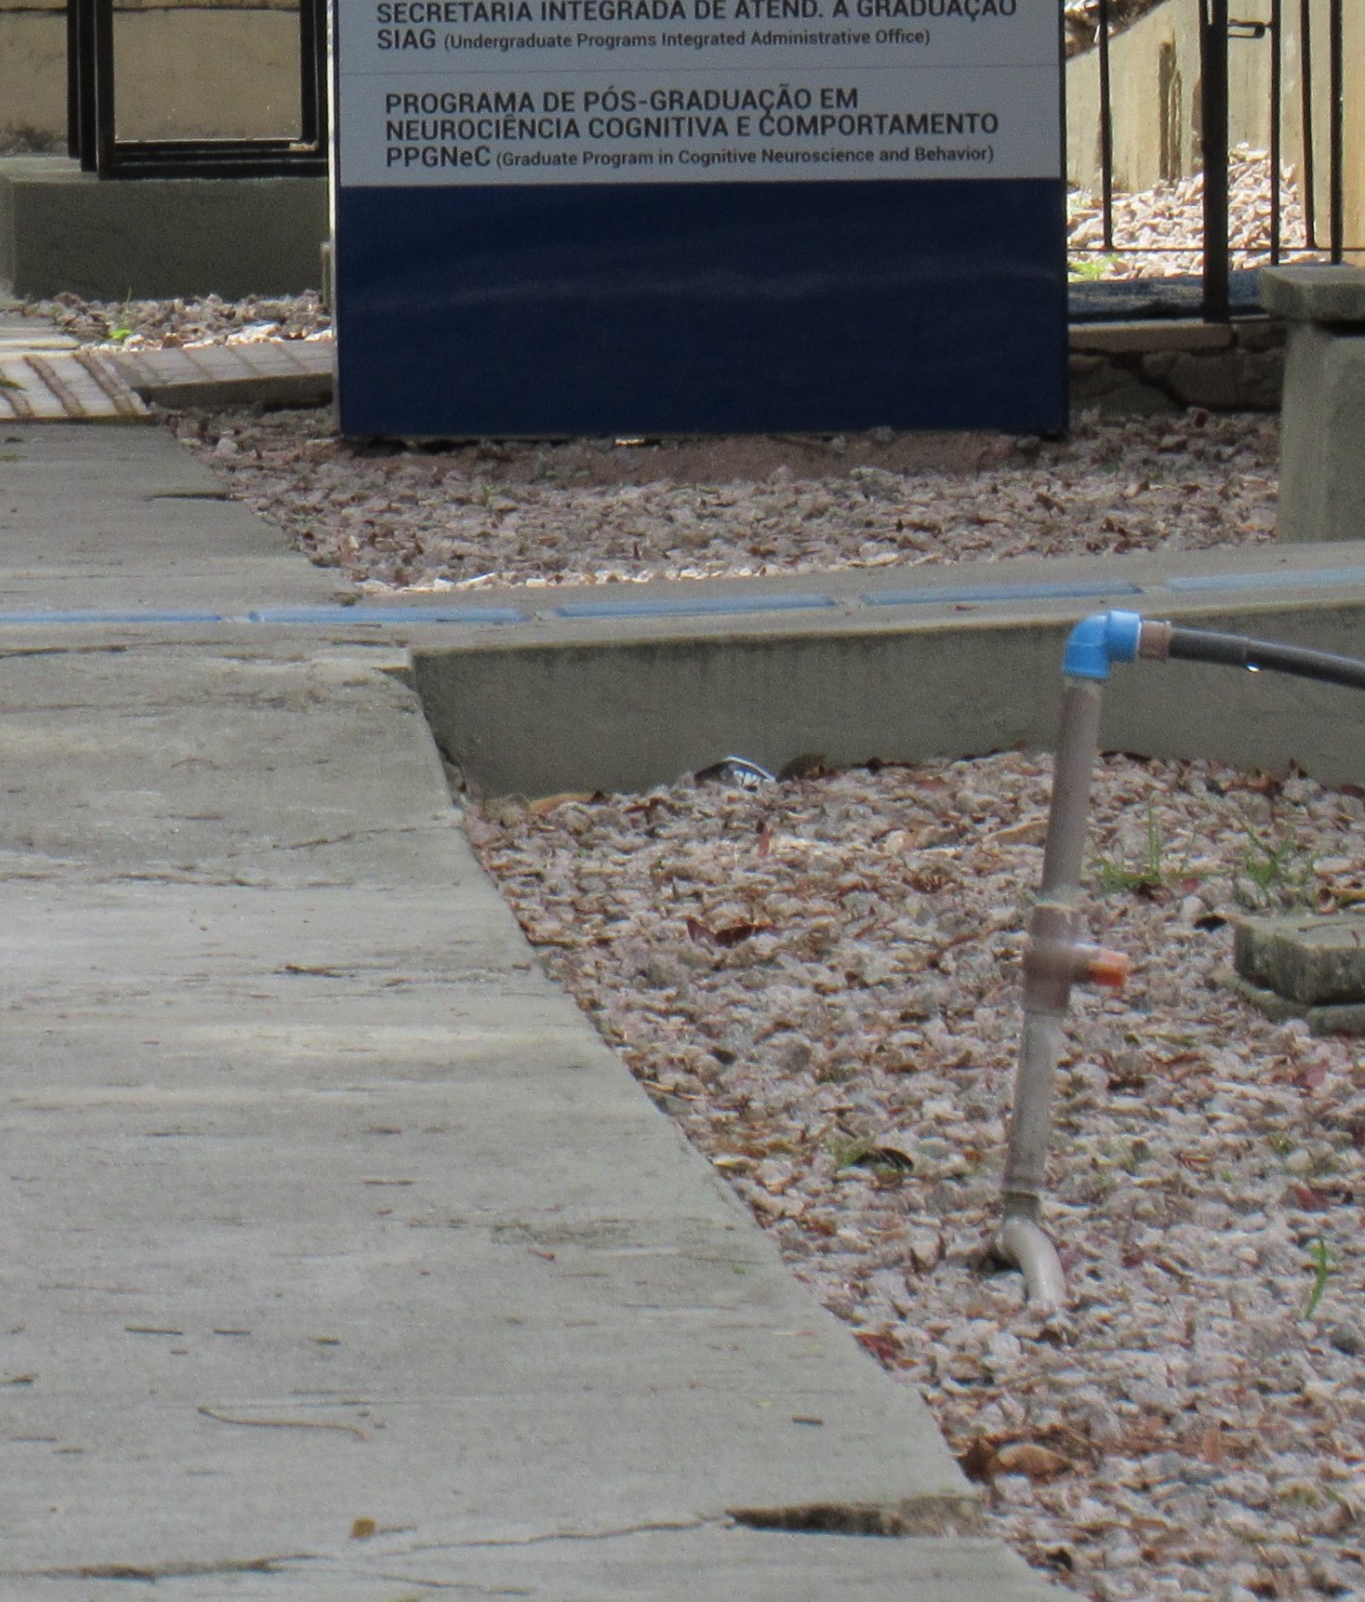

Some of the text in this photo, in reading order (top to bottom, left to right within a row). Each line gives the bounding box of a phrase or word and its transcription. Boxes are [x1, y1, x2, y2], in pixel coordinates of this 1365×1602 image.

[376, 0, 534, 24] SECRETARIA
[376, 27, 931, 53] SIAG (Undergraduate Programs Integrated Administrative Office)
[384, 82, 859, 115] PROGRAMA DE PÓS-GRADUAÇÃO EM
[385, 112, 1000, 142] NEUROCIÊNCIA COGNITIVA E COMPORTAMENTO
[386, 144, 995, 170] PPGNeC (Graduate Program in Cognitive Neuroscience and Behavior)
